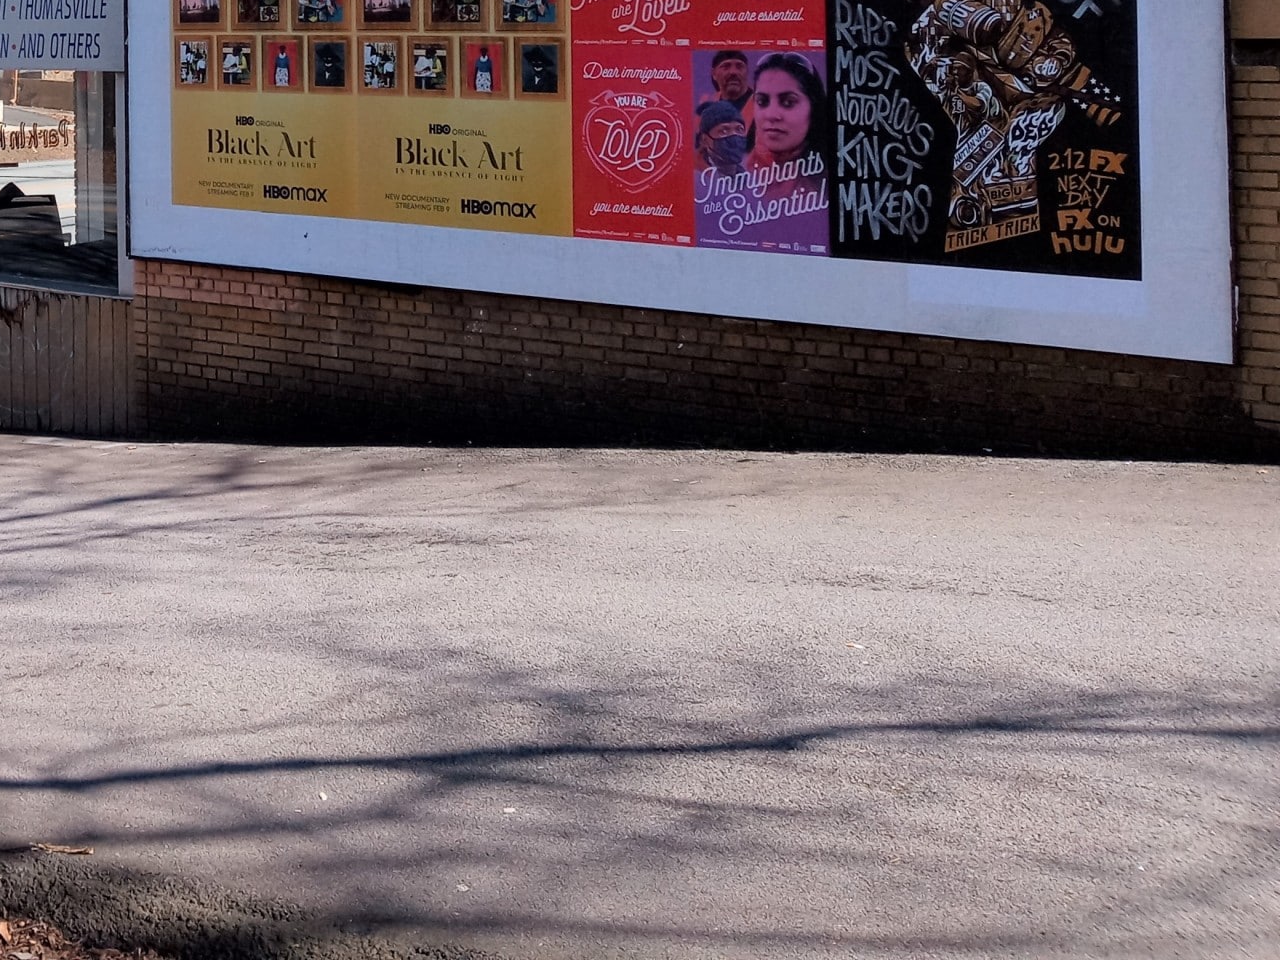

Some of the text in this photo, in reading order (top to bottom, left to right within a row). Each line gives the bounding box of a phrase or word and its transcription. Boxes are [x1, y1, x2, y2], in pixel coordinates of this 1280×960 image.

[611, 3, 632, 19] are
[714, 8, 804, 26] you are essential.
[19, 33, 45, 59] AND
[50, 33, 101, 59] OTHERS
[583, 62, 682, 84] Dear immigrants,
[835, 46, 900, 90] MOST
[614, 96, 648, 108] YOU ARE
[235, 116, 285, 128] HBO ORIGINAL
[429, 123, 487, 137] HBO ORIGINAL
[836, 84, 934, 156] NOTORIOUS
[208, 129, 320, 158] Black Art
[395, 137, 525, 171] Black Art
[238, 158, 273, 167] ABSENCE
[291, 161, 317, 169] LIGHT
[837, 125, 923, 185] KING
[1048, 148, 1128, 174] 2.12 FX
[212, 181, 254, 190] DOCUMENTARY
[410, 168, 426, 176] THE
[432, 169, 471, 179] ABSENCE
[494, 173, 525, 182] LIGHT
[694, 150, 825, 204] Immigrants
[1057, 171, 1117, 192] NEXT
[208, 188, 238, 196] STREAMING
[401, 194, 450, 203] DOCUMENTARY
[990, 187, 1022, 200] BIG U
[1058, 185, 1110, 209] DAY
[395, 202, 432, 212] STREAMING
[433, 204, 445, 212] FEB
[590, 203, 611, 216] you
[613, 203, 630, 213] are
[704, 178, 829, 235] are Essential
[839, 180, 933, 243] MAKERS
[1057, 208, 1120, 231] FX ON
[946, 217, 1039, 250] TRICK TRICK
[1051, 231, 1125, 255] hulu
